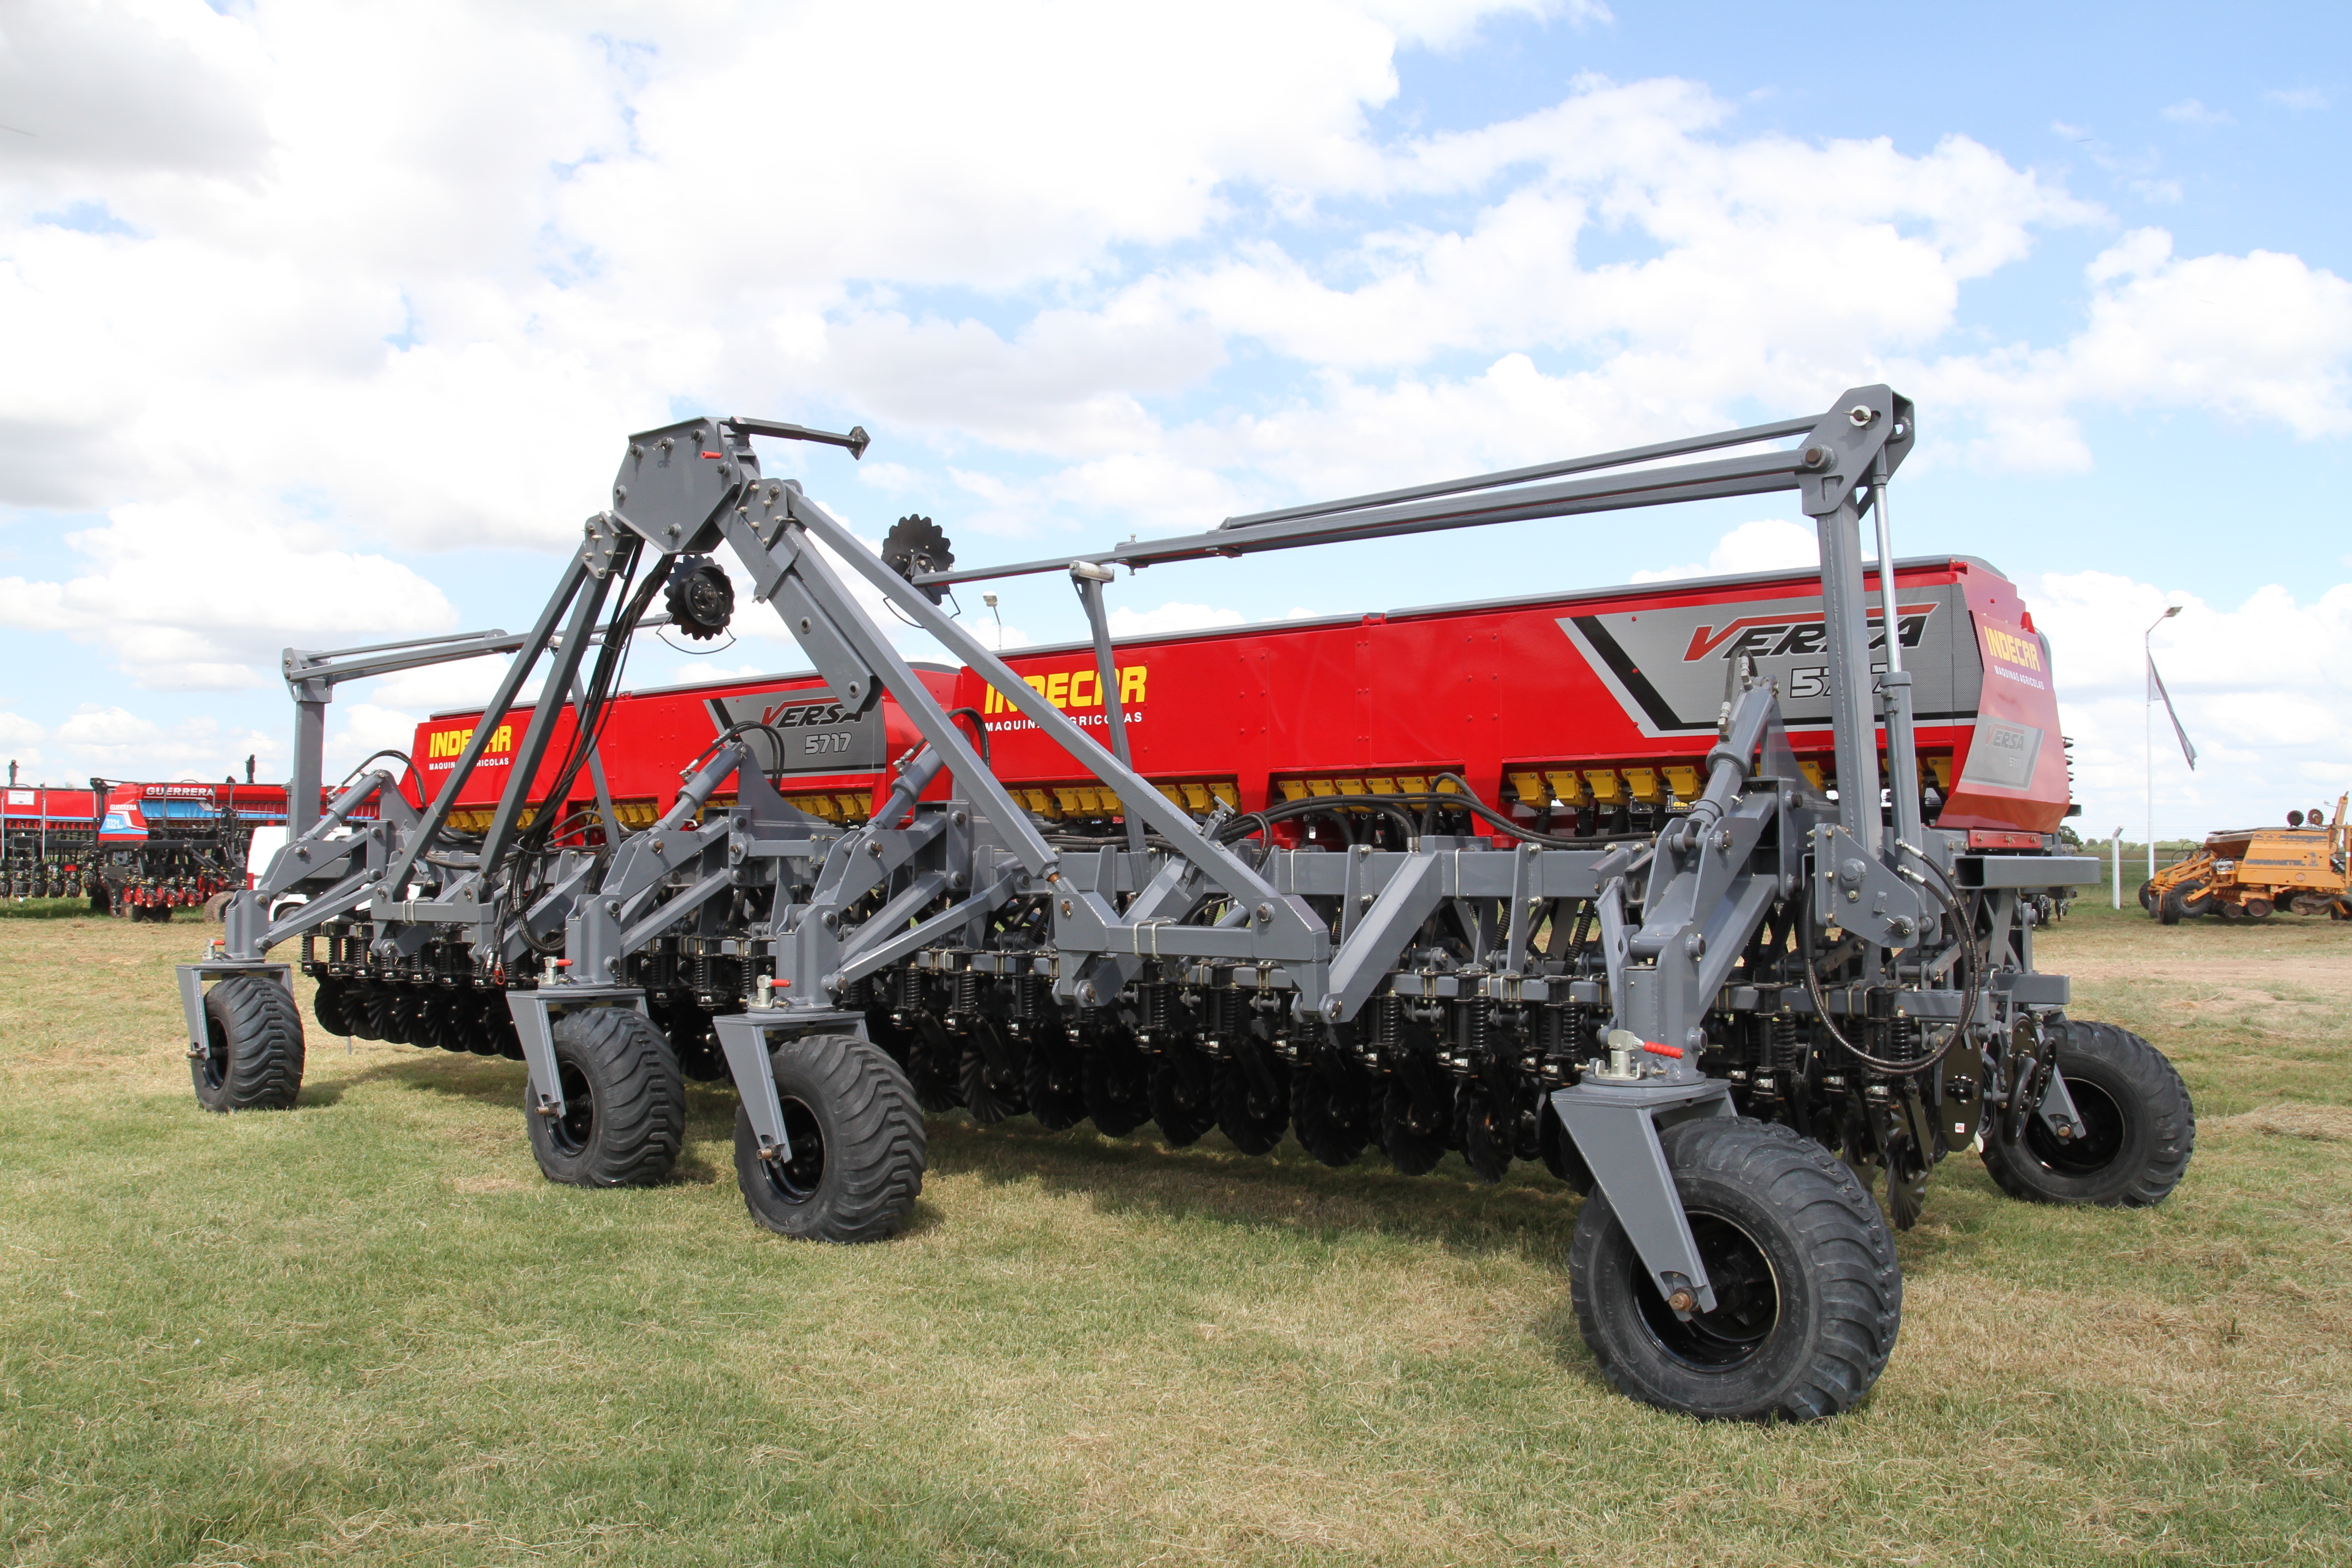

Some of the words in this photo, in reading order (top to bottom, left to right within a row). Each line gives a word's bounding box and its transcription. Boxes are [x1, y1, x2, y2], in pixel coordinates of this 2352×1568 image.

[1682, 602, 1940, 662] VERA
[1984, 625, 2041, 672] INDECAR
[1994, 665, 2019, 682] MAQUINAS
[2019, 674, 2044, 690] AGRICOLAS
[985, 720, 1042, 732] MAQUIN
[1068, 711, 1142, 726] GRICAS
[429, 725, 512, 758] INDEAR
[804, 732, 852, 755] 5717
[1985, 722, 2025, 752] VERSA
[429, 761, 456, 770] MAQUIN
[475, 757, 510, 767] RICOLAS
[146, 787, 214, 796] GUERRERA
